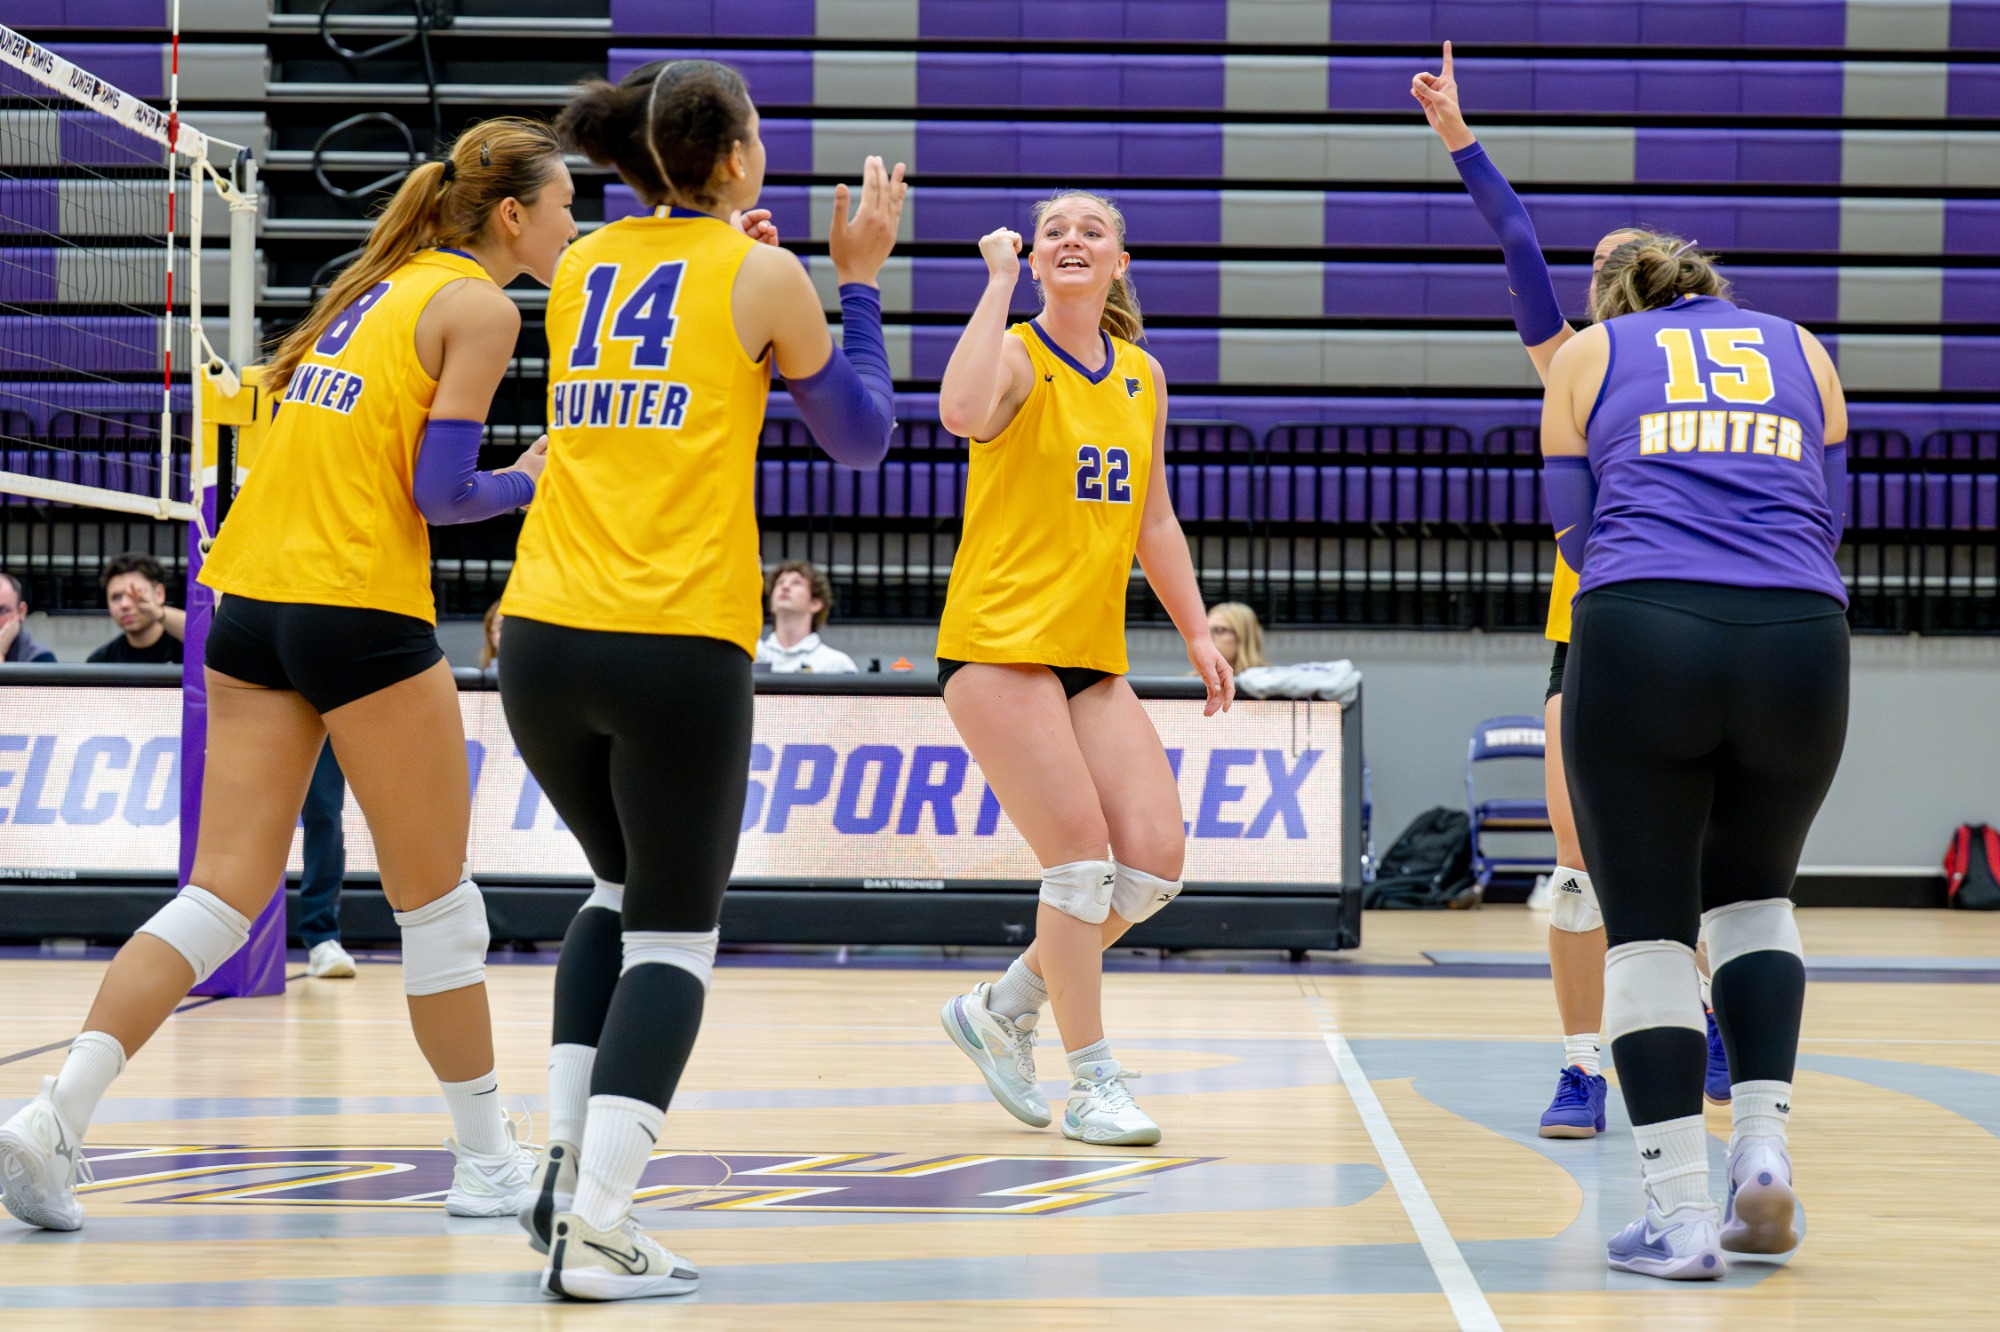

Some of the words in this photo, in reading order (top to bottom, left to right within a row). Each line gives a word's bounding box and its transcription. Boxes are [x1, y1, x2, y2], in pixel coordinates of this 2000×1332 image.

[569, 259, 688, 371] 14
[283, 363, 364, 415] UNTER
[1655, 327, 1775, 405] 15
[550, 379, 692, 429] HUNTER
[1640, 410, 1802, 462] HUNTER
[1075, 444, 1132, 504] 22
[1484, 728, 1545, 747] HUNTE
[863, 878, 945, 890] DAKTRONICS
[1561, 885, 1582, 894] adidas
